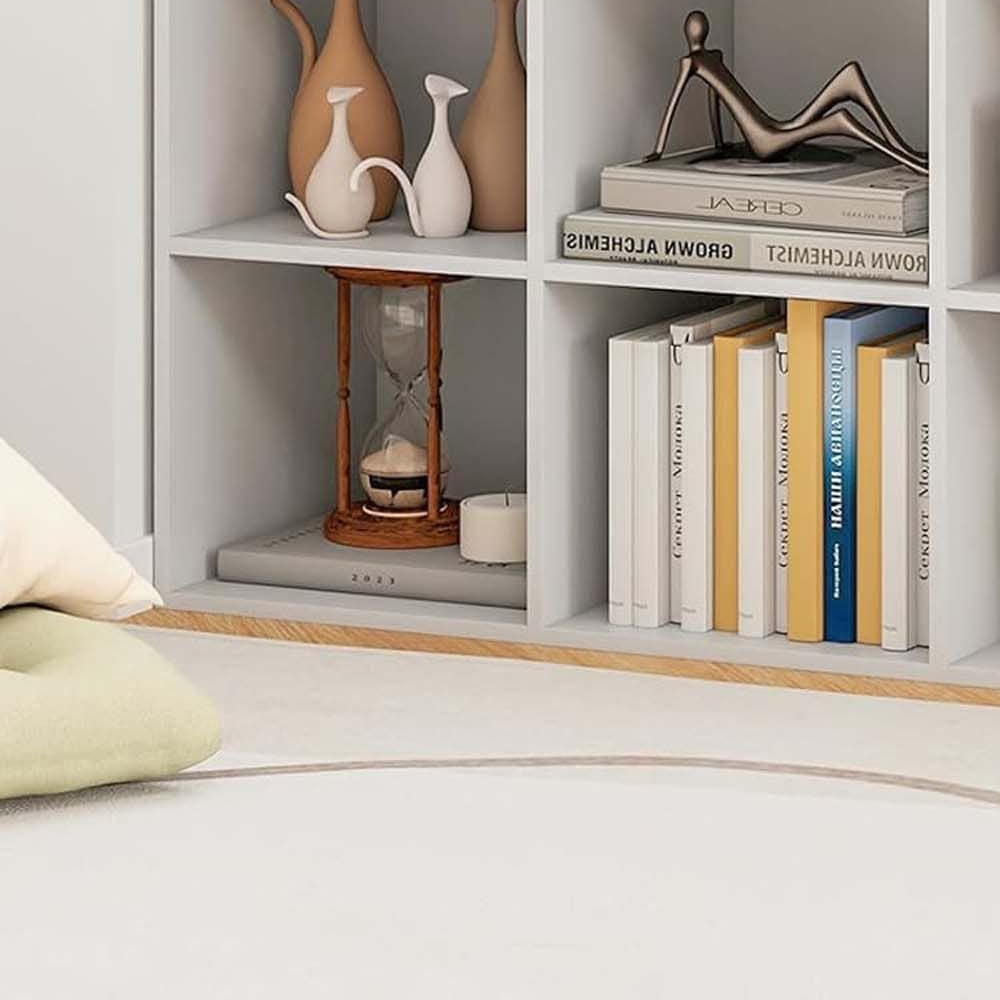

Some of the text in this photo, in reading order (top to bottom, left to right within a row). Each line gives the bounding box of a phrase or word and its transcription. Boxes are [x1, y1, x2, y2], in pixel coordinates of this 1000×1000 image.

[778, 412, 789, 486] Молока
[831, 471, 843, 529] НАШИ
[918, 423, 930, 581] Секрет Молока
[352, 574, 396, 585] 2023
